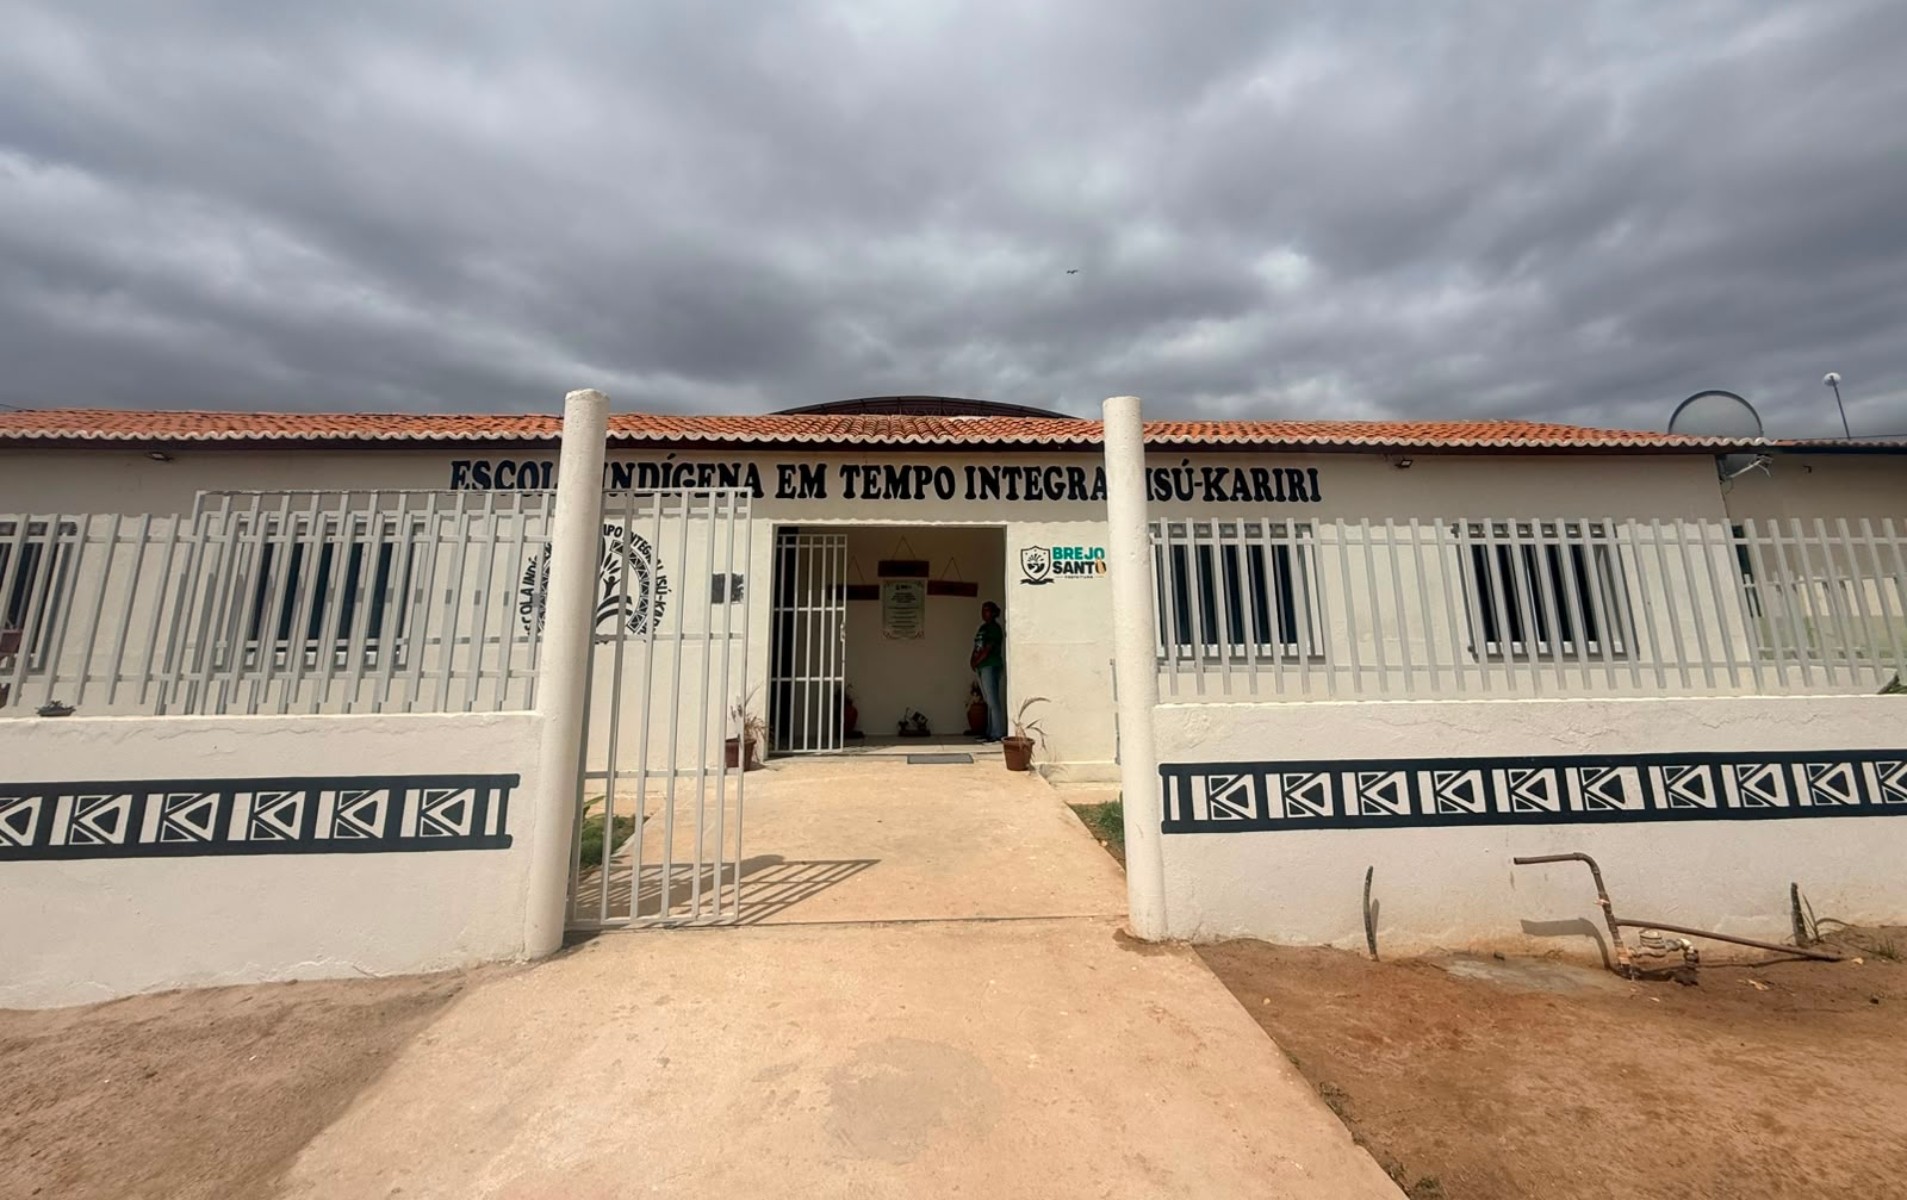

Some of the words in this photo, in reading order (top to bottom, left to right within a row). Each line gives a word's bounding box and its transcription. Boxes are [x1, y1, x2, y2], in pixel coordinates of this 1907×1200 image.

[451, 460, 559, 497] ESCOL
[775, 464, 828, 499] EM
[839, 464, 956, 500] TEMPO
[964, 465, 1107, 501] INTEGRA
[1052, 547, 1105, 560] BREJO
[1052, 561, 1107, 574] SANTO
